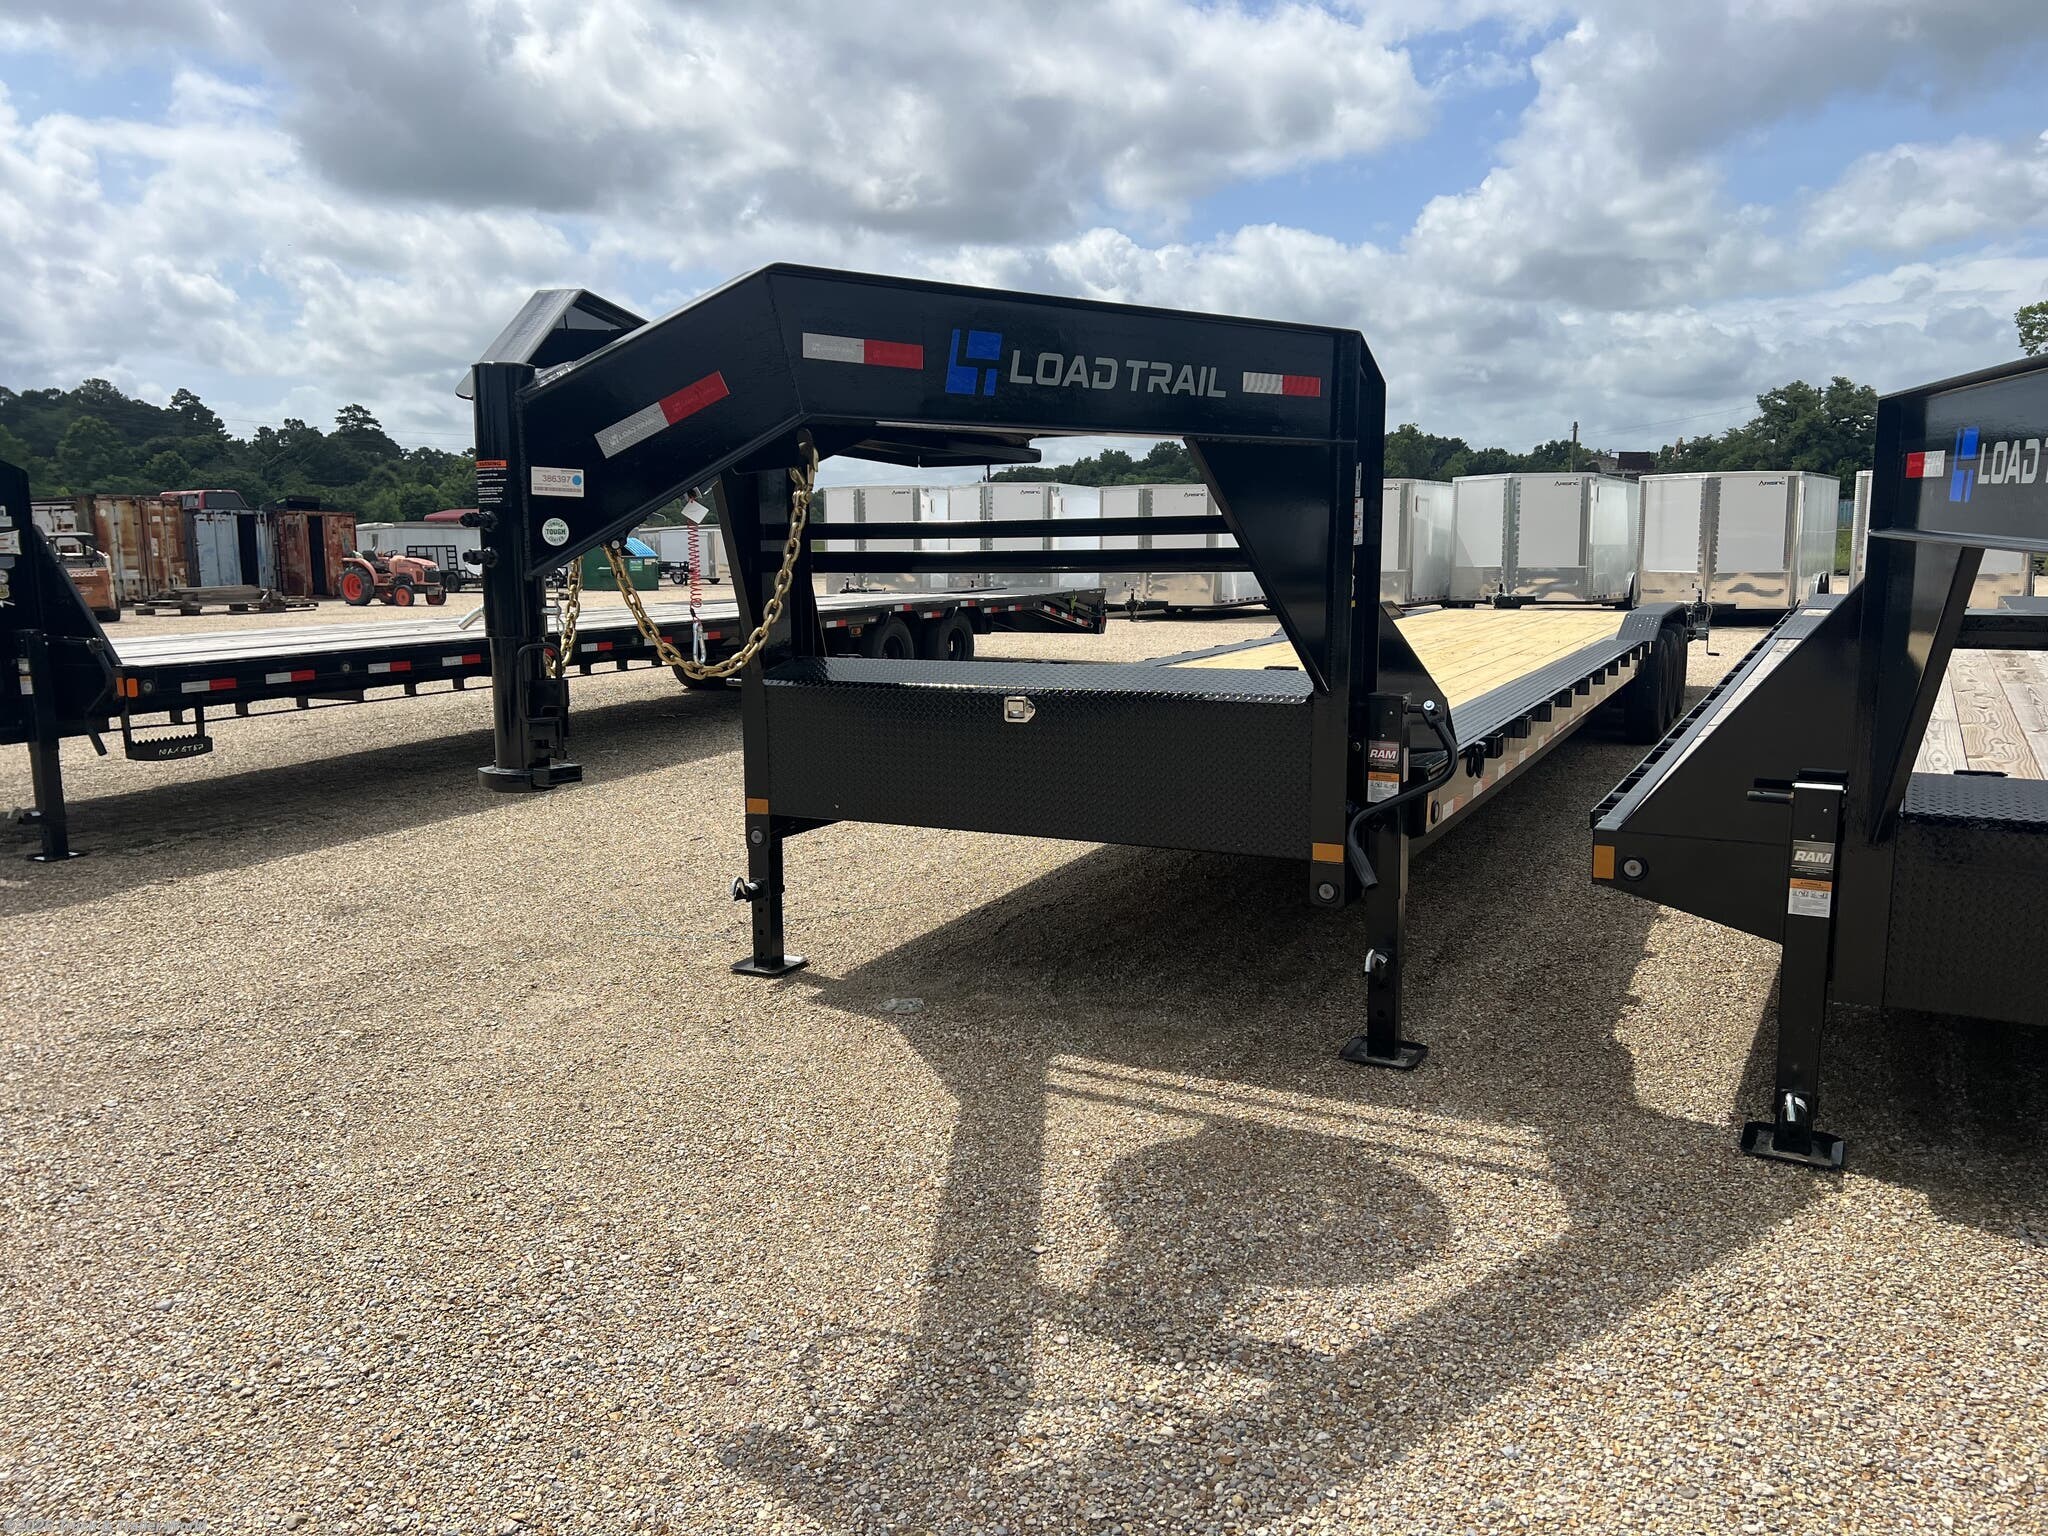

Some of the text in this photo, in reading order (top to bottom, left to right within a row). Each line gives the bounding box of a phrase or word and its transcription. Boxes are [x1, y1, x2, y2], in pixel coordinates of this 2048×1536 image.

[1009, 350, 1227, 398] LOAD TRAIL
[1977, 438, 2041, 484] LOAD
[542, 474, 571, 483] 386397
[1369, 749, 1397, 760] RAM
[1794, 850, 1832, 864] RAM
